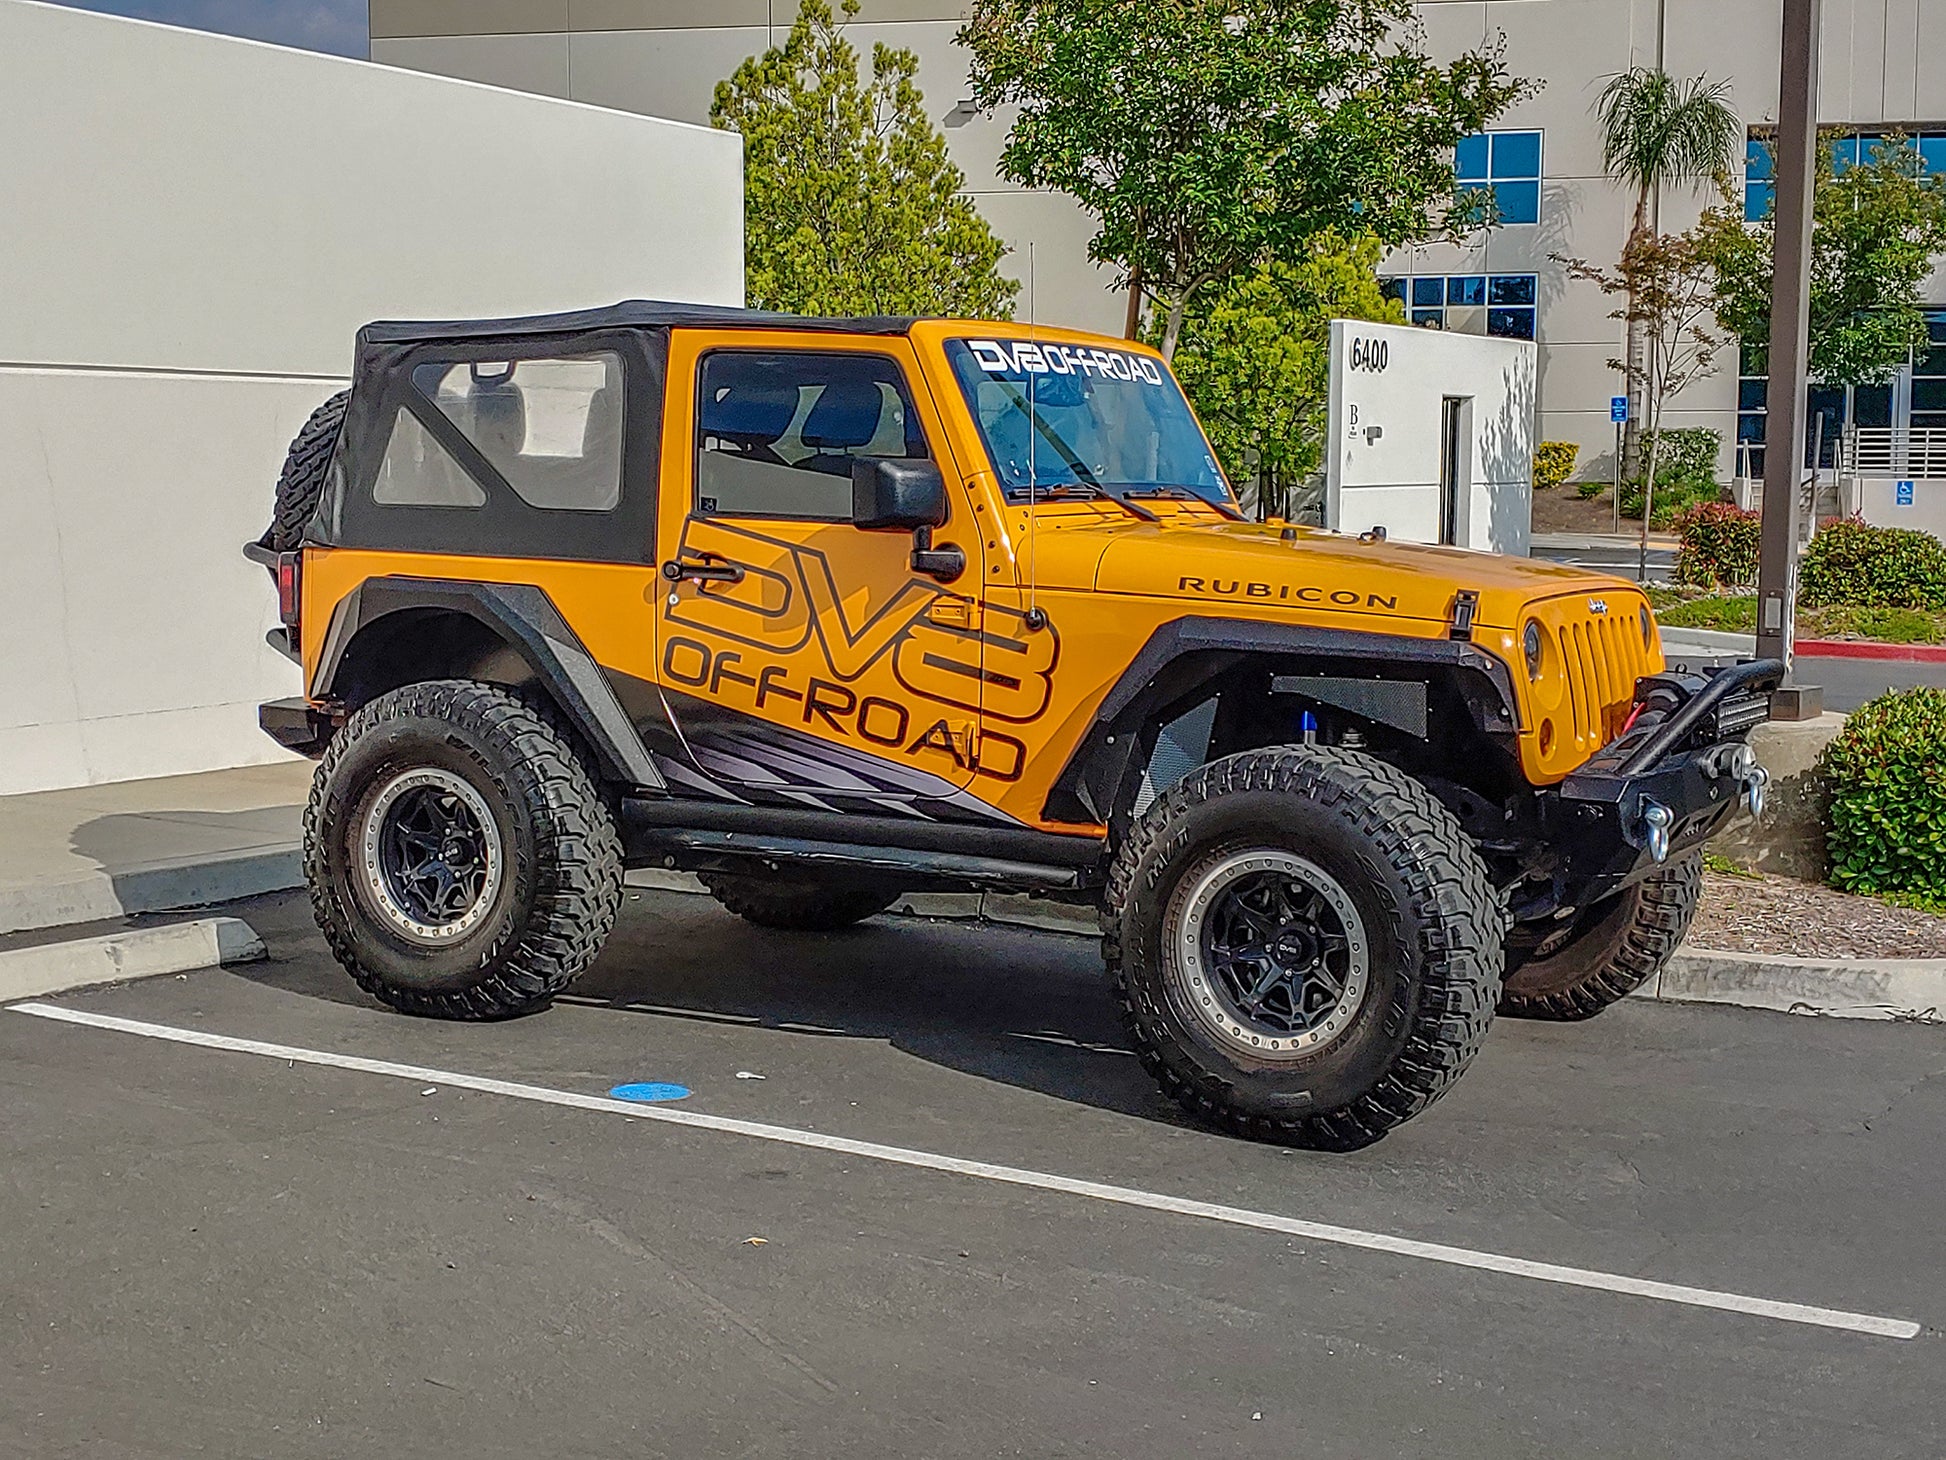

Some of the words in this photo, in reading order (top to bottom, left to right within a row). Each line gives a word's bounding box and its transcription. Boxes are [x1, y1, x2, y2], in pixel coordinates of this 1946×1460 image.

[967, 340, 1050, 374] DV8
[1352, 337, 1389, 370] 6400
[1178, 577, 1398, 609] RUBICON
[664, 513, 1060, 724] DV8
[663, 636, 1028, 783] OFFROAD
